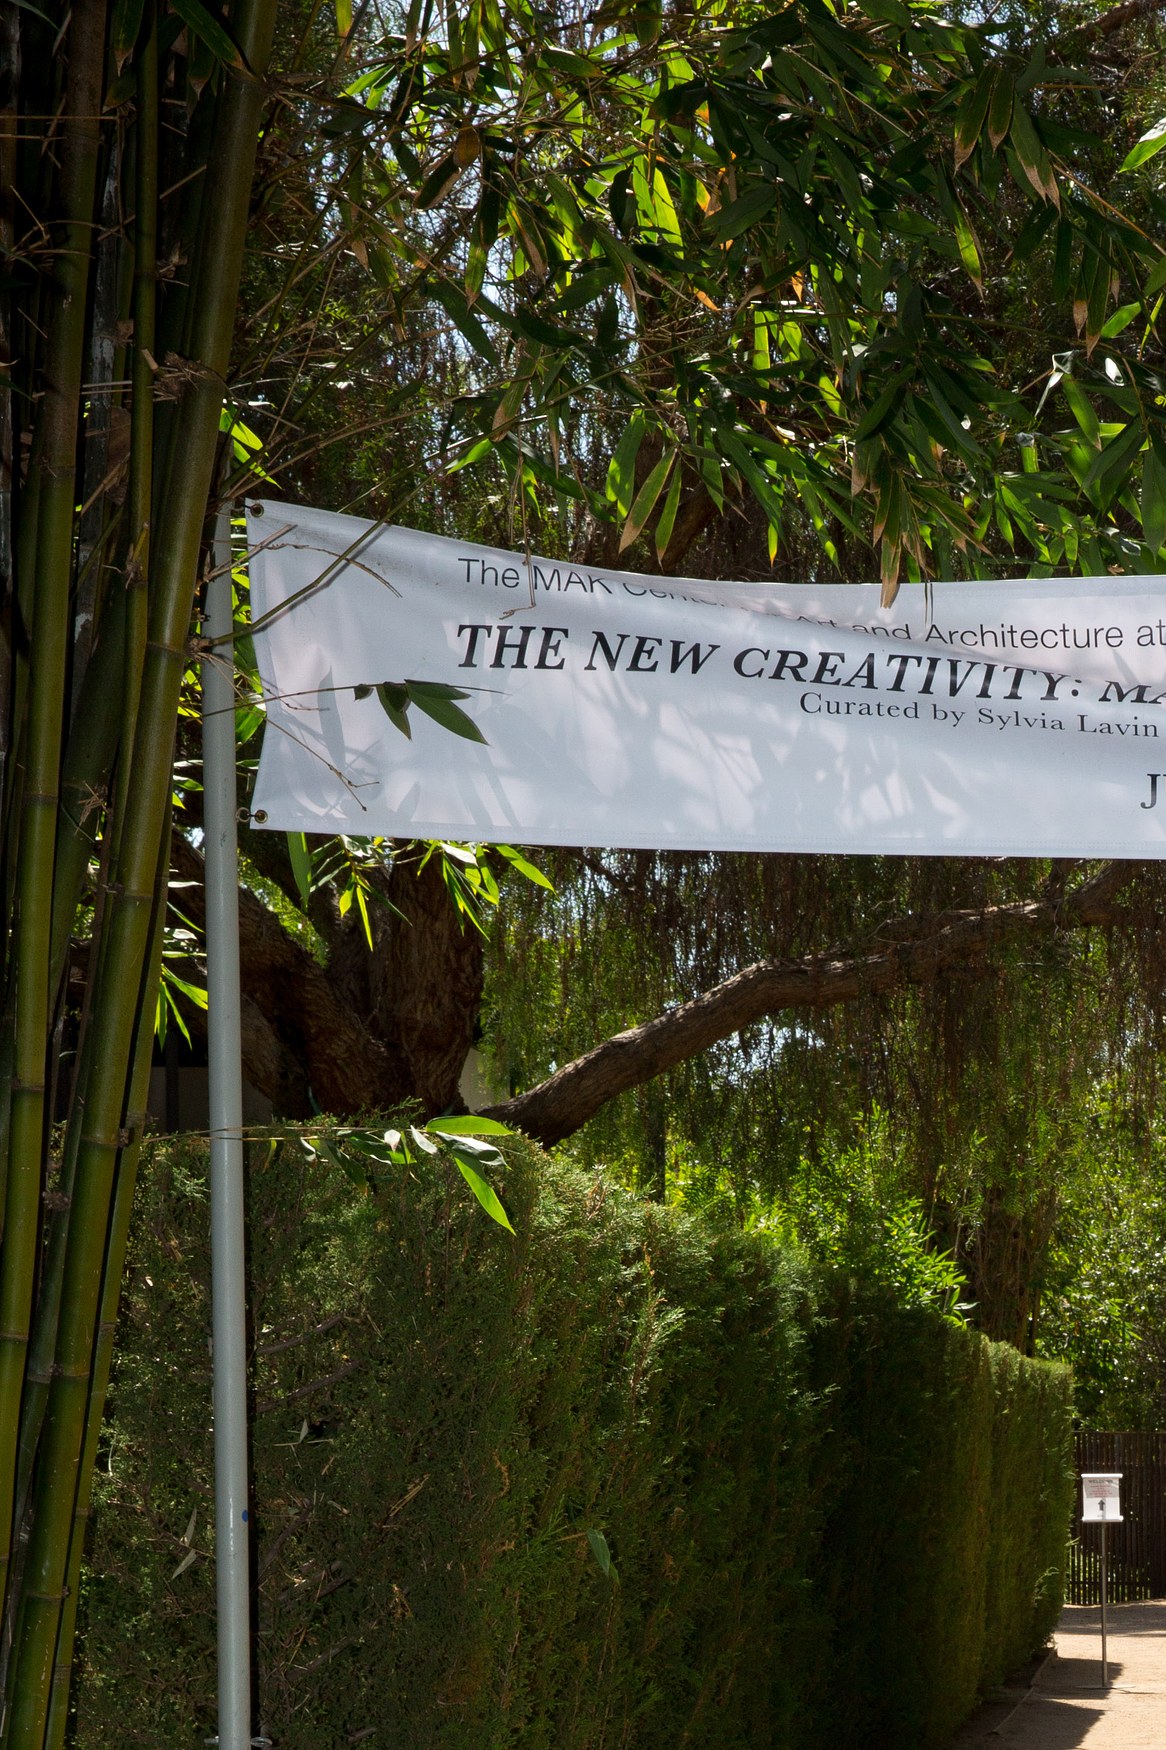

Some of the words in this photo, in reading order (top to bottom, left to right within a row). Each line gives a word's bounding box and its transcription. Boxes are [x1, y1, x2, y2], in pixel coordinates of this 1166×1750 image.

[458, 558, 519, 588] The
[532, 565, 612, 594] MAK
[851, 622, 912, 640] and
[925, 622, 1124, 649] Architecture
[1136, 618, 1166, 647] at
[456, 624, 569, 670] THE
[584, 631, 720, 674] NEW
[733, 647, 1082, 701] CREATIVITY:
[800, 692, 919, 719] Curated
[932, 704, 965, 727] by
[978, 708, 1065, 731] Sylvia
[1077, 714, 1159, 738] Lavin
